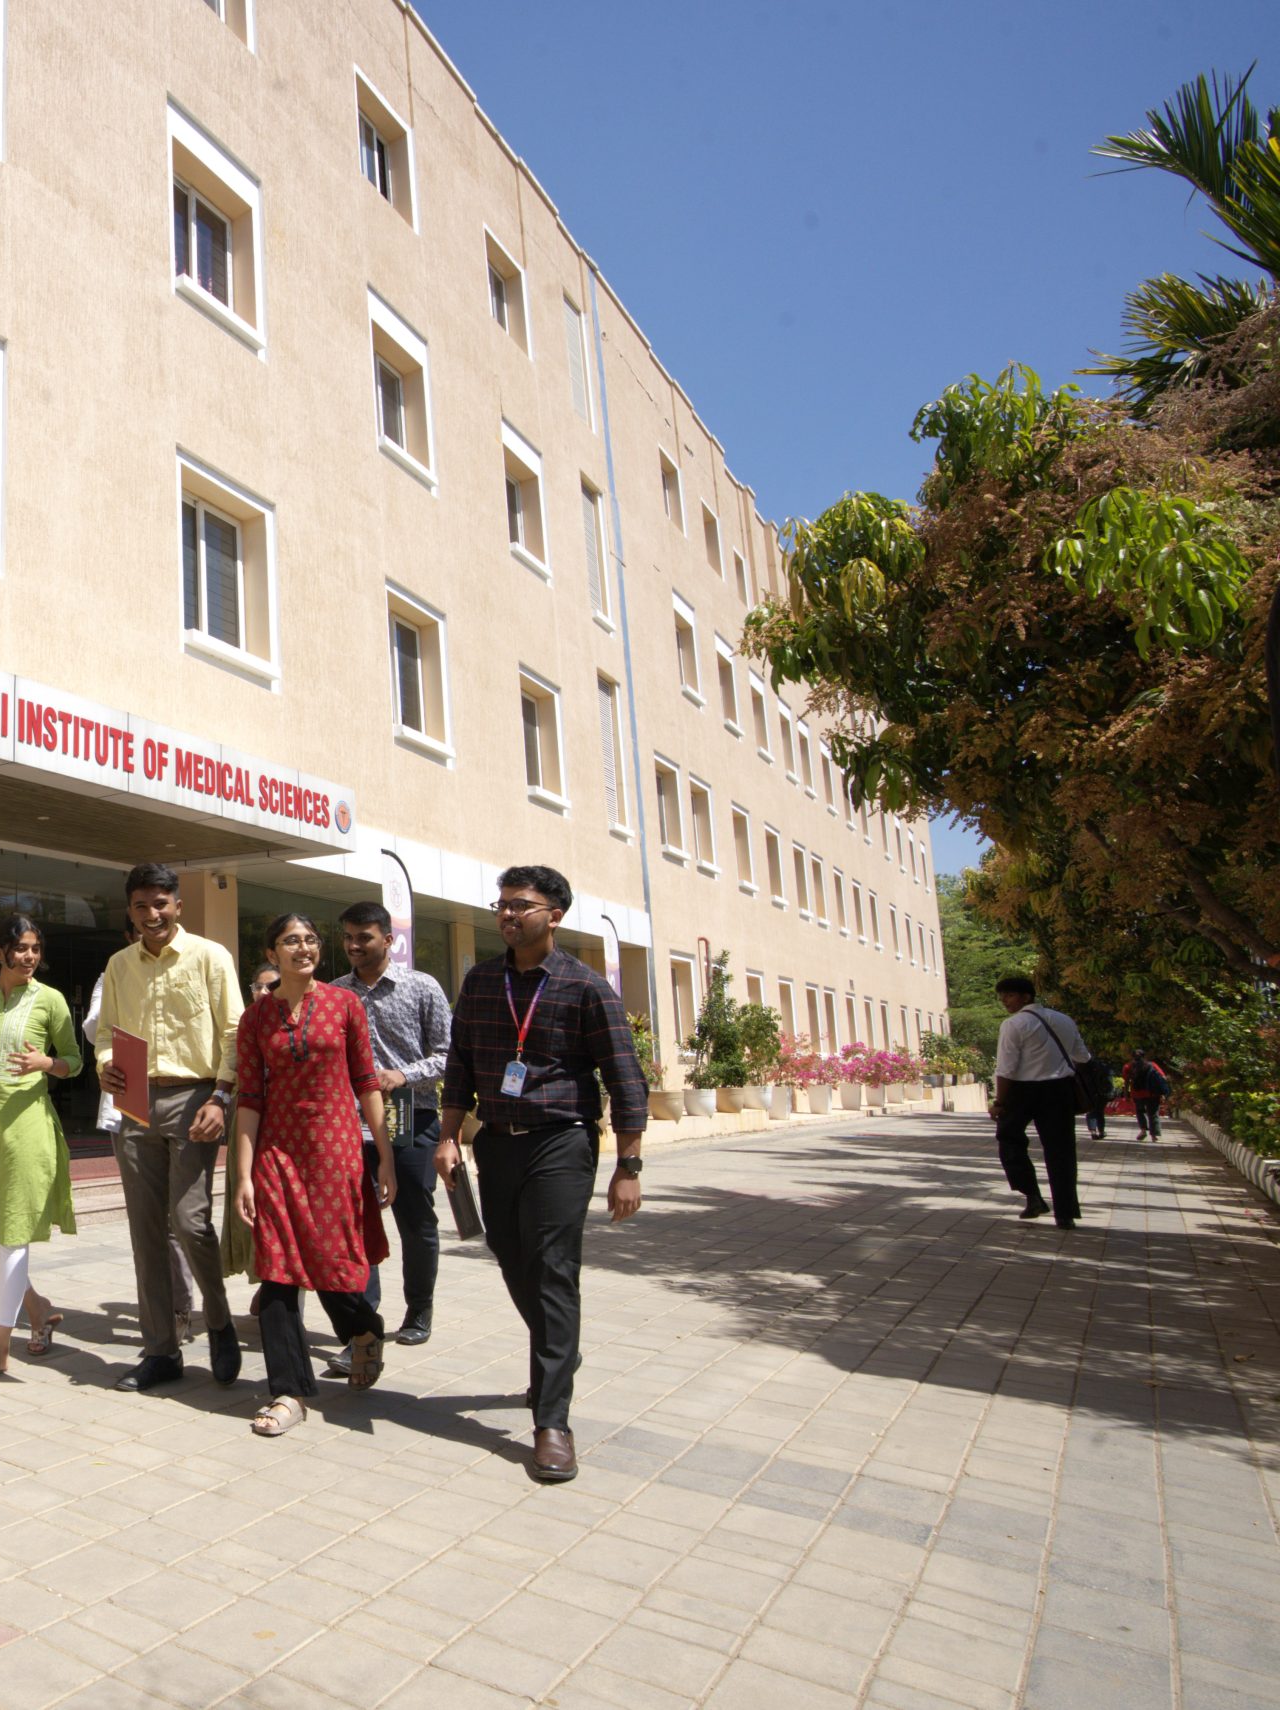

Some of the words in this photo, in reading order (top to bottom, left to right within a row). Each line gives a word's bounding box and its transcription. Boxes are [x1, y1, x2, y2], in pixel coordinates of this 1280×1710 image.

[17, 698, 135, 774] INSTITUTE
[143, 737, 169, 780] OF
[175, 747, 255, 808] MEDICAL
[258, 774, 331, 829] SCIENCES
